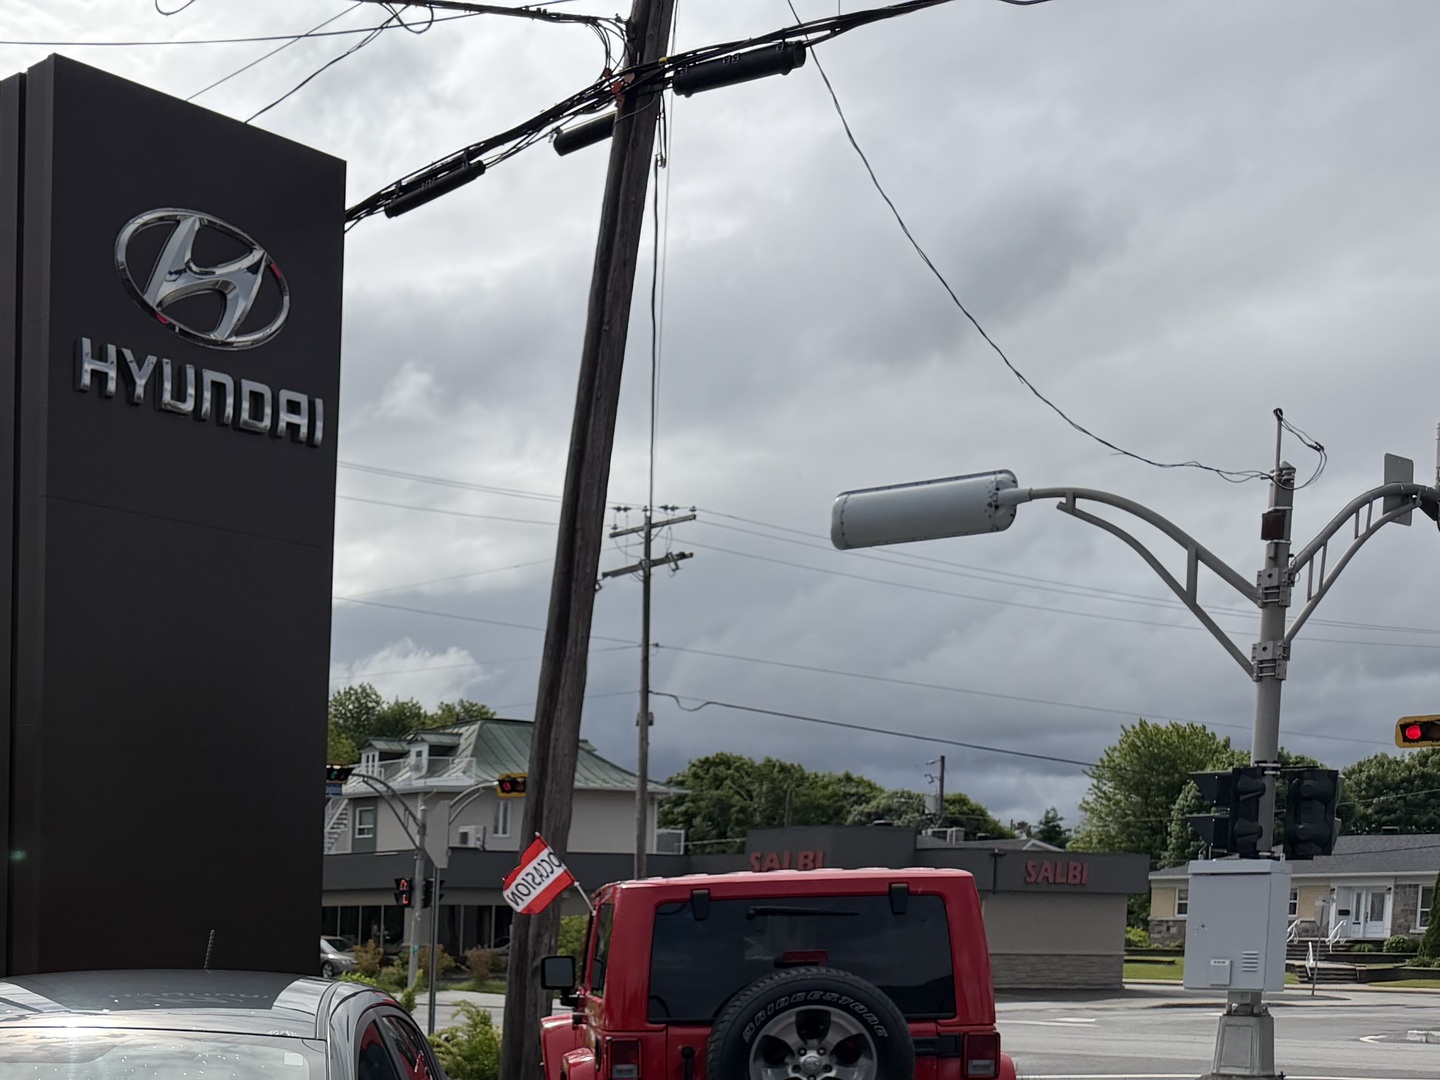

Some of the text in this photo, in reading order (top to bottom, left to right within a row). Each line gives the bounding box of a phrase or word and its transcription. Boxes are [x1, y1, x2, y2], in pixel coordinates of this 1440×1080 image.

[80, 337, 323, 446] HYUNDAI
[1025, 860, 1088, 885] SALBI
[743, 991, 888, 1044] BRIDGESTONE
